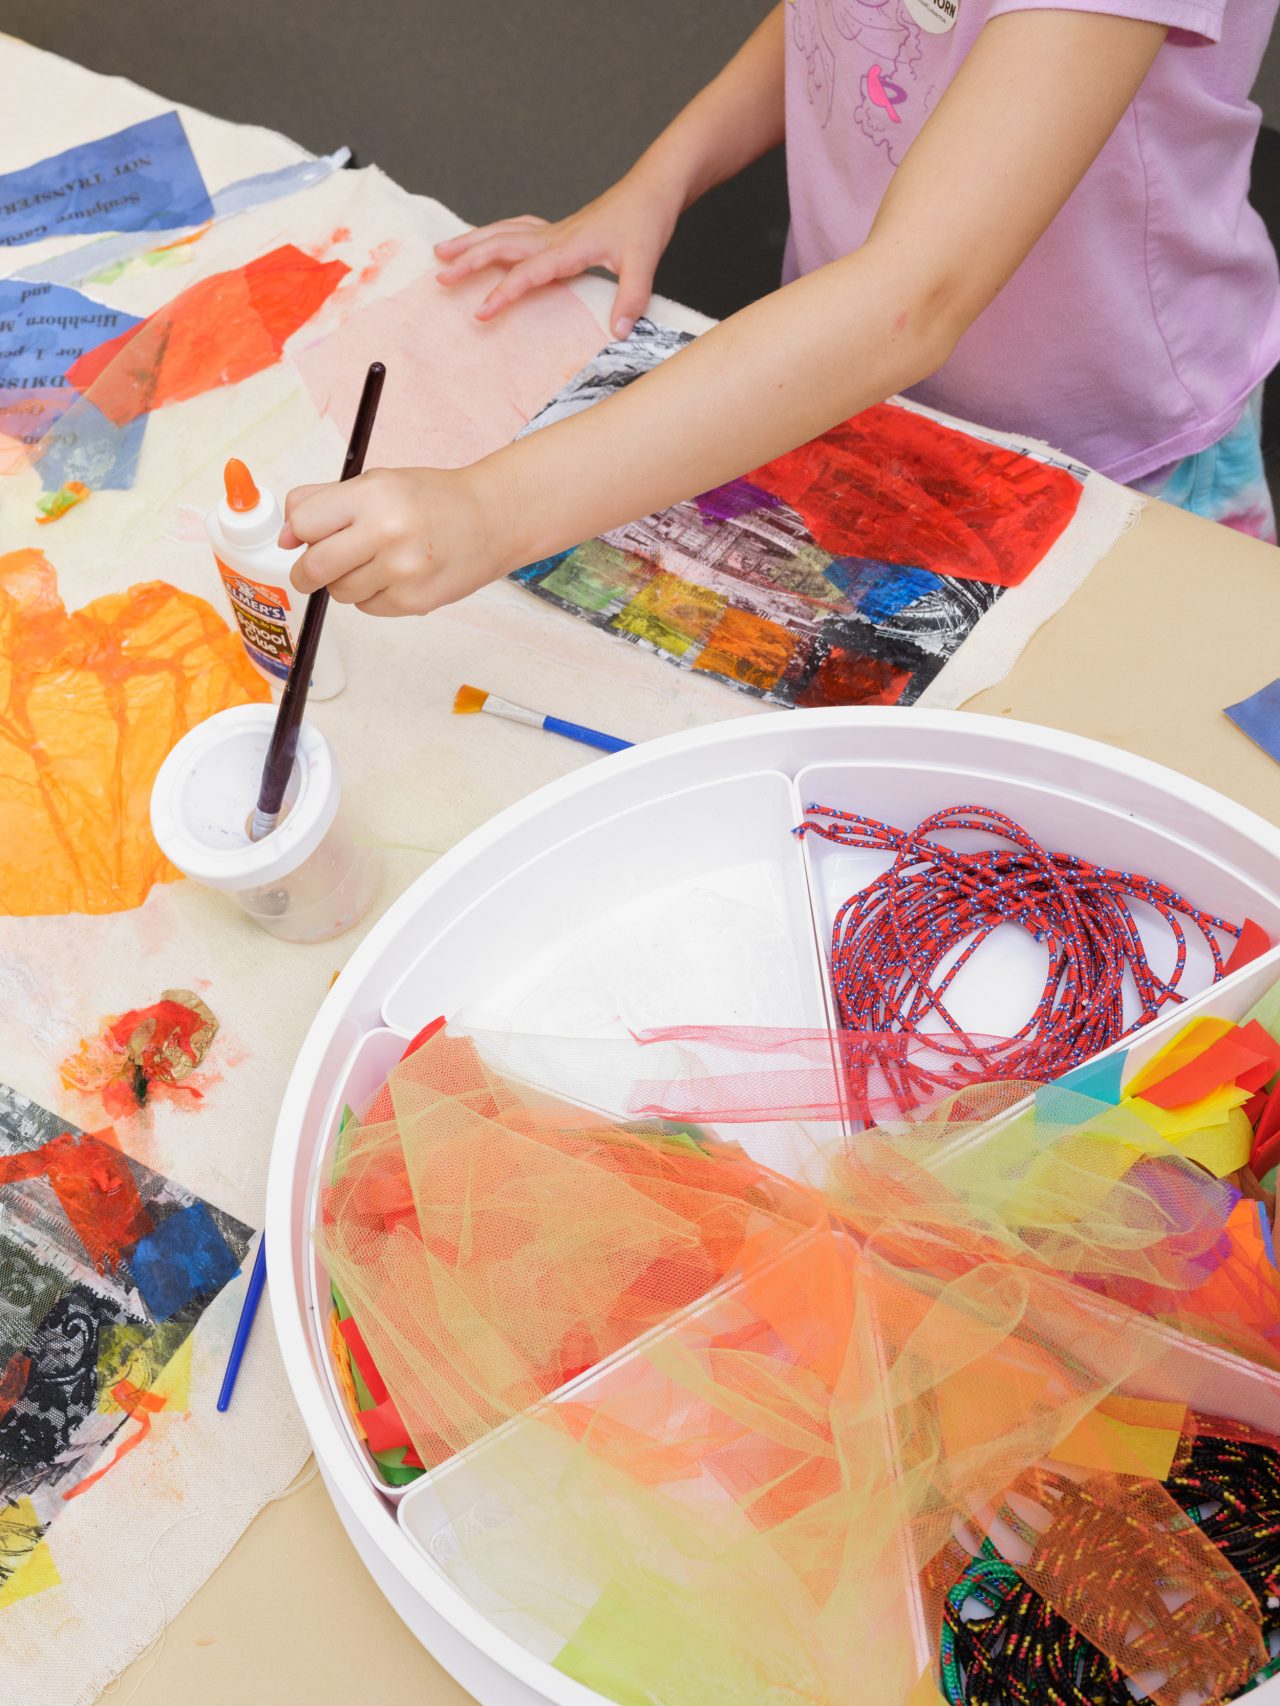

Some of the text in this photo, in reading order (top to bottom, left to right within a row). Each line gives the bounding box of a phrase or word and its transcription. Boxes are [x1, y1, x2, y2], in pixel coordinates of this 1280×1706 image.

[113, 154, 153, 177] NOT
[56, 191, 141, 224] Sculpture
[20, 285, 52, 303] and
[26, 314, 119, 330] Hirshhorn
[56, 347, 84, 360] for
[224, 582, 282, 618] ELMER'S
[236, 610, 288, 647] School
[244, 627, 278, 655] Glue
